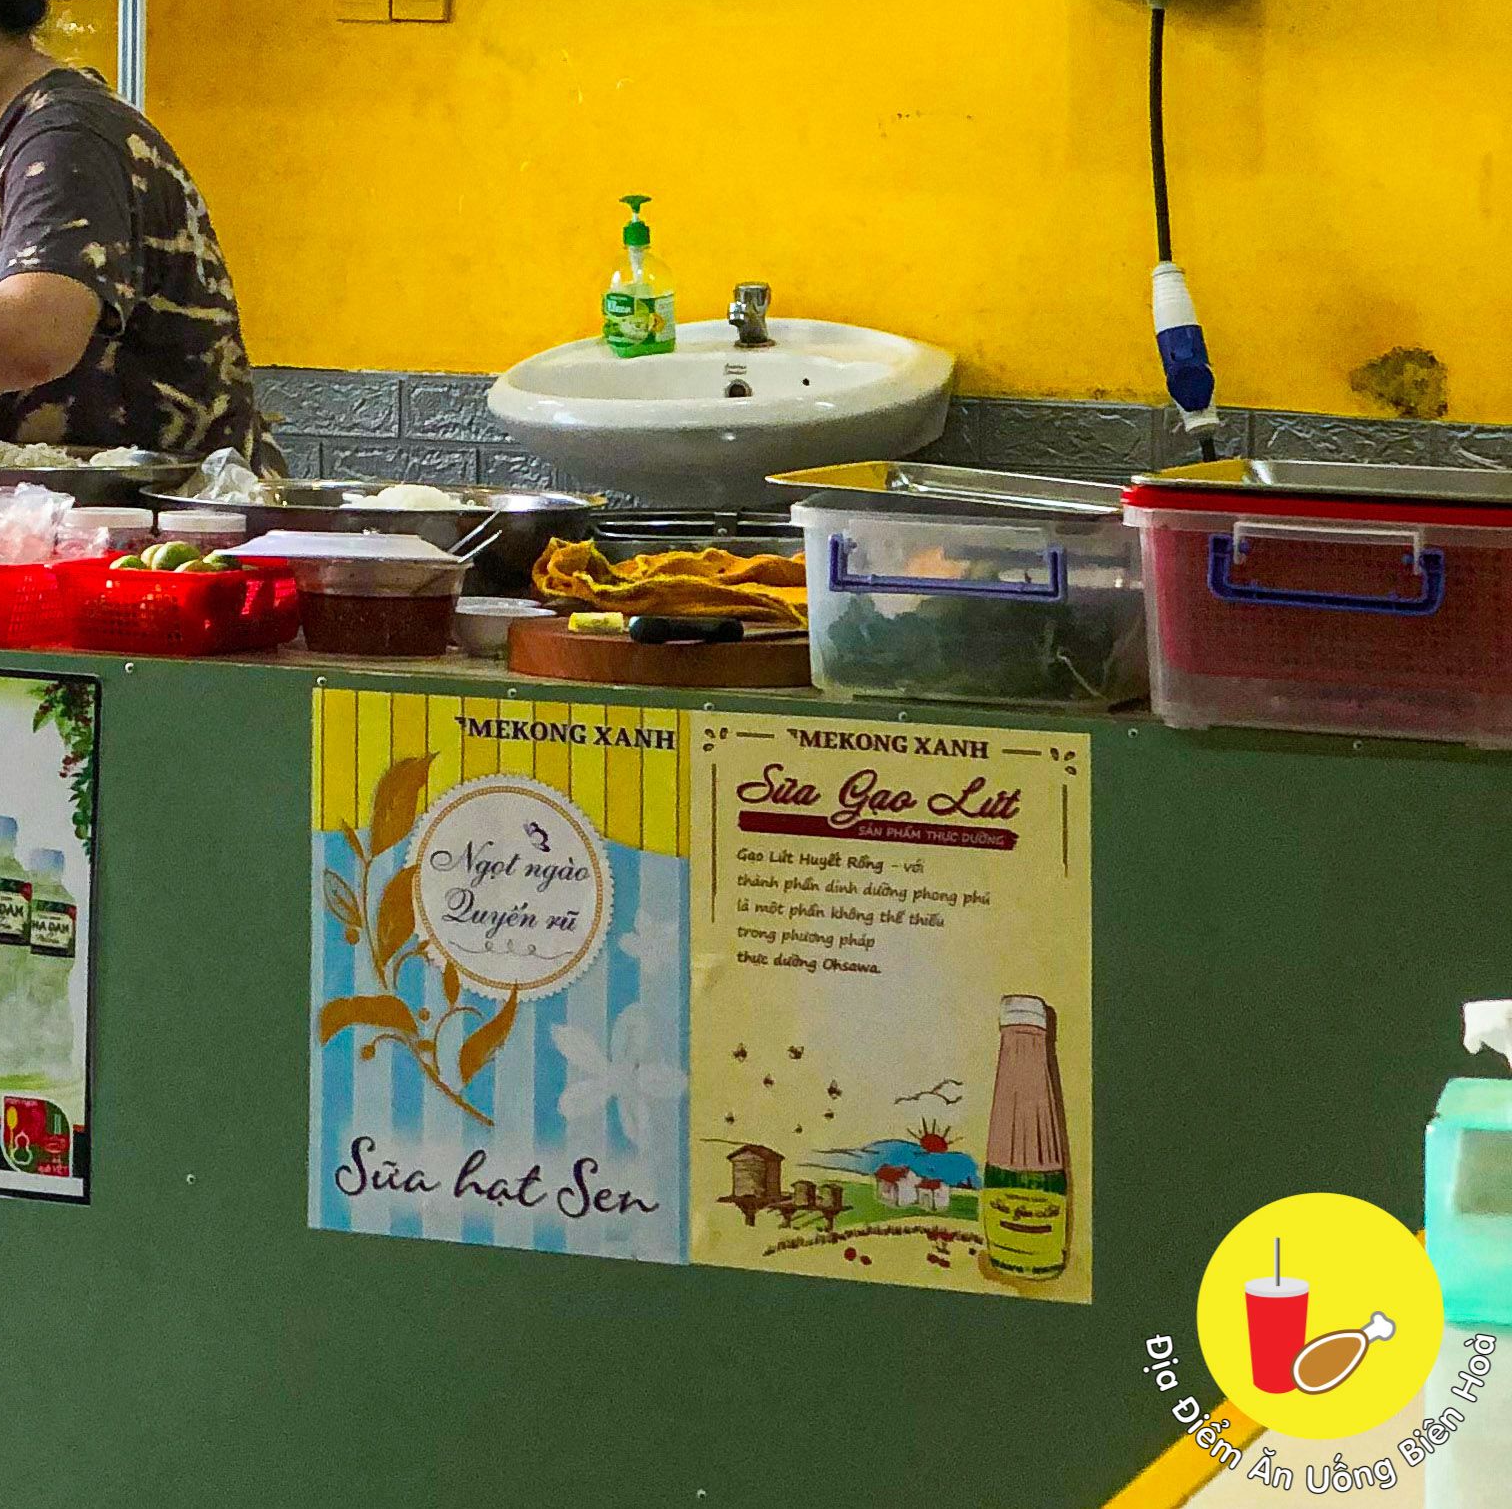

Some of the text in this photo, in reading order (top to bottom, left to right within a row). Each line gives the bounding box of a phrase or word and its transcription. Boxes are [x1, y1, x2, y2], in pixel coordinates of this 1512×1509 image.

[455, 716, 675, 750] MEKONG XANH
[787, 729, 989, 759] MEKONG XANH
[736, 763, 822, 806] Sữa
[828, 769, 917, 824] Gạo
[430, 841, 590, 892] Ngọt ngào
[442, 887, 579, 938] Quyến rũ
[913, 887, 958, 907] phong
[737, 926, 777, 942] trong
[839, 932, 876, 951] pháp
[335, 1136, 659, 1219] Sữa hạt Sen
